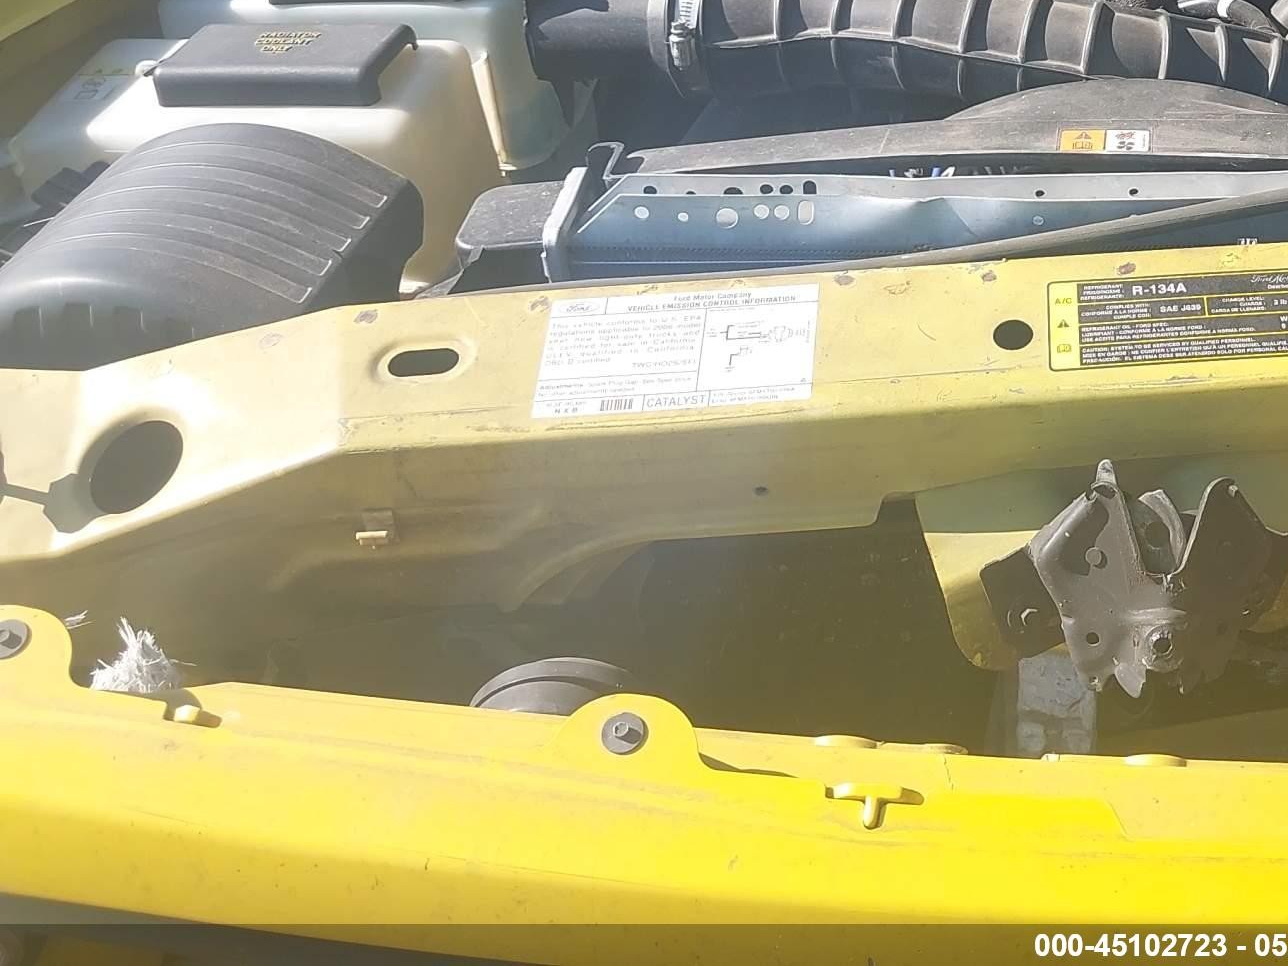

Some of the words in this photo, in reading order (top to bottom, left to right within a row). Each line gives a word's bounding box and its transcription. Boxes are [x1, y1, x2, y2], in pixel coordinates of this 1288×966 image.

[255, 38, 313, 46] COOLANT
[1132, 282, 1188, 297] R-134A
[716, 291, 752, 299] Company
[627, 304, 658, 312] VEHICLE
[661, 301, 700, 310] EMISSION
[702, 299, 738, 307] CONTROL
[741, 295, 796, 305] INFORMATION
[1055, 297, 1072, 305] A/C
[566, 304, 590, 312] Ford
[1160, 305, 1179, 313] SAE
[646, 394, 705, 408] CATALYST
